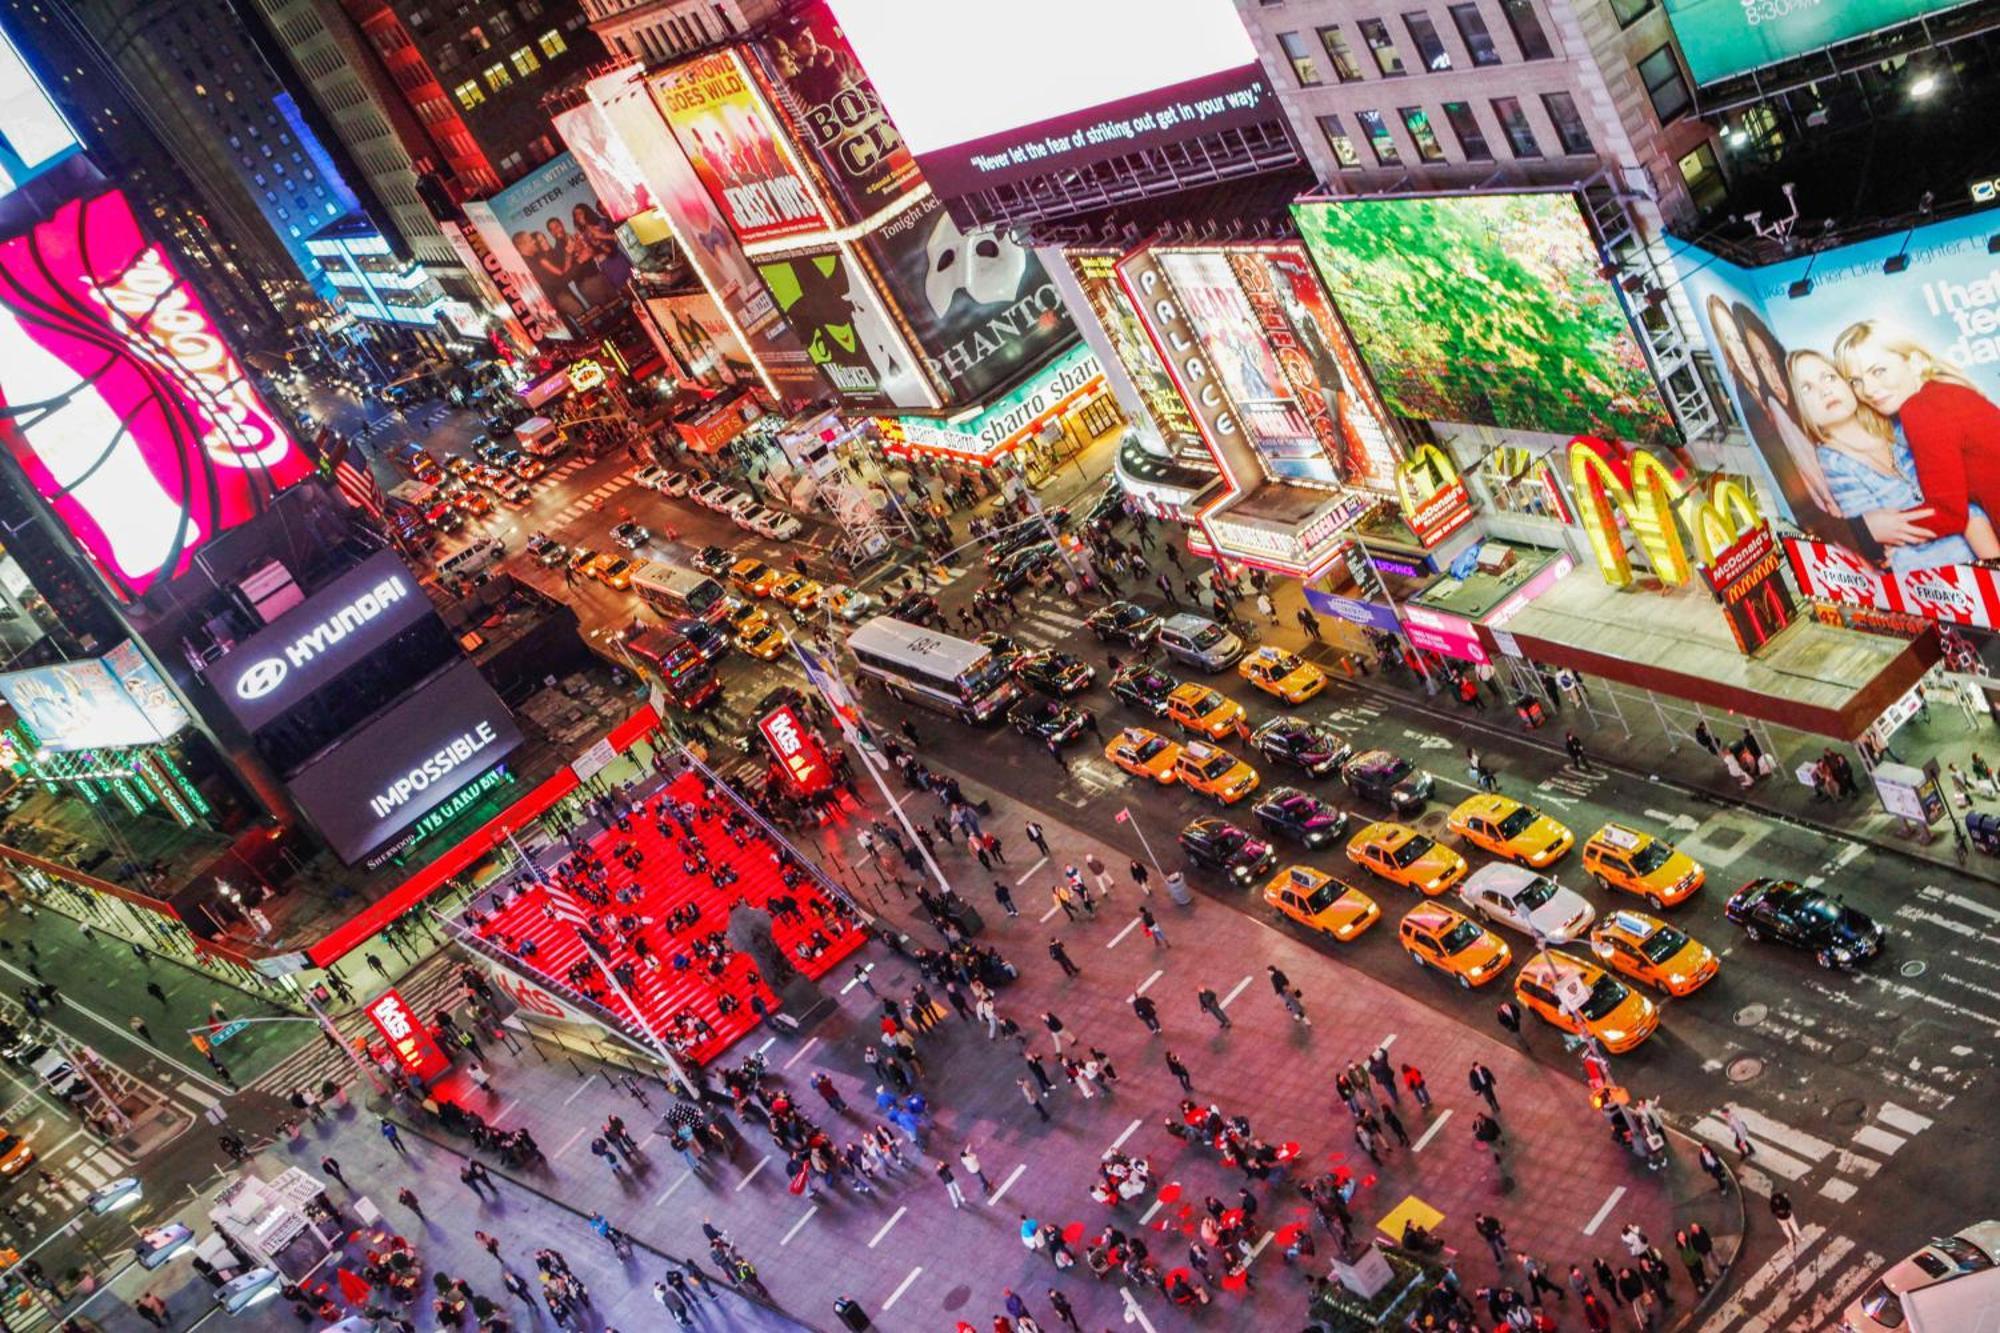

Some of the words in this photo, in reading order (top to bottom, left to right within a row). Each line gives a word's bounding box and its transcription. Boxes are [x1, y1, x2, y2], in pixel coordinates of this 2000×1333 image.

[703, 75, 748, 103] WILD!
[1010, 146, 1025, 163] let
[1025, 142, 1047, 160] the
[1047, 137, 1071, 154] fear
[1072, 130, 1086, 147] of
[1086, 120, 1135, 145] striking
[1135, 113, 1157, 131] out
[1156, 108, 1179, 130] get
[1179, 102, 1195, 121] in
[1195, 98, 1225, 121] your
[523, 187, 564, 217] BETTER
[879, 206, 923, 240] Tonight
[1139, 268, 1237, 437] PALACE
[705, 415, 742, 446] GIFTS
[981, 394, 1045, 450] sbarro
[1413, 486, 1464, 527] McDonald's
[1713, 530, 1769, 581] McDonald's
[285, 576, 408, 668] HYUNDAI
[767, 712, 802, 757] tkts
[370, 720, 498, 818] IMPOSSIBLE
[372, 996, 413, 1041] tkts
